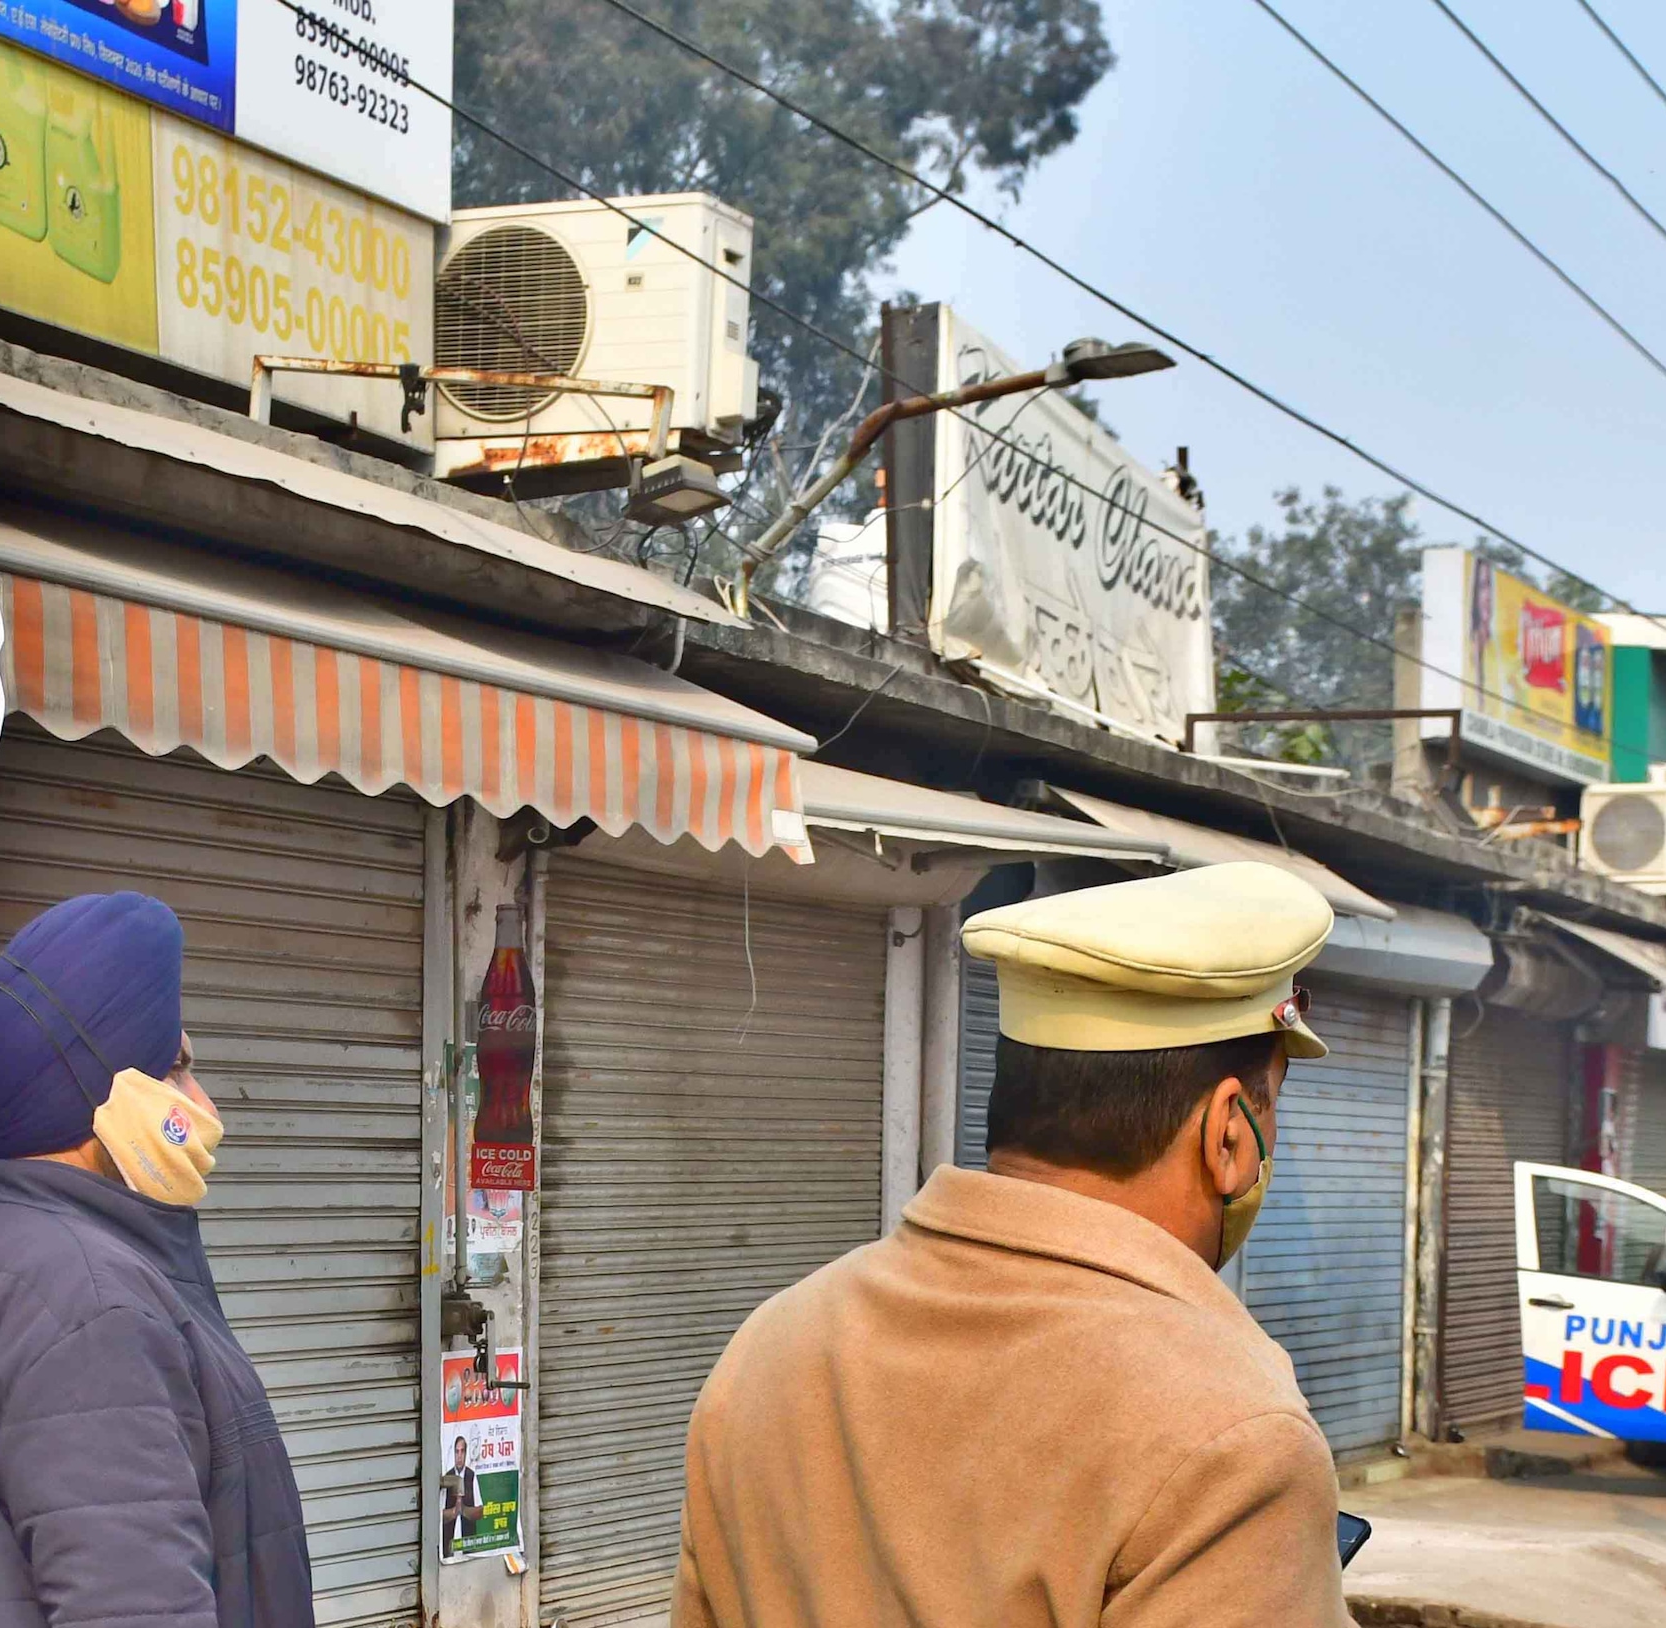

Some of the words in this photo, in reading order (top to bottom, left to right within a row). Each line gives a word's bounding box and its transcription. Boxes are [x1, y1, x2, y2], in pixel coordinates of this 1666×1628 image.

[296, 5, 410, 88] 85905-00005
[295, 54, 409, 135] 98763-92323
[173, 144, 411, 300] 98152-43000
[176, 237, 412, 365] 85905-00005
[476, 1148, 495, 1160] ICE
[498, 1149, 532, 1161] COLD
